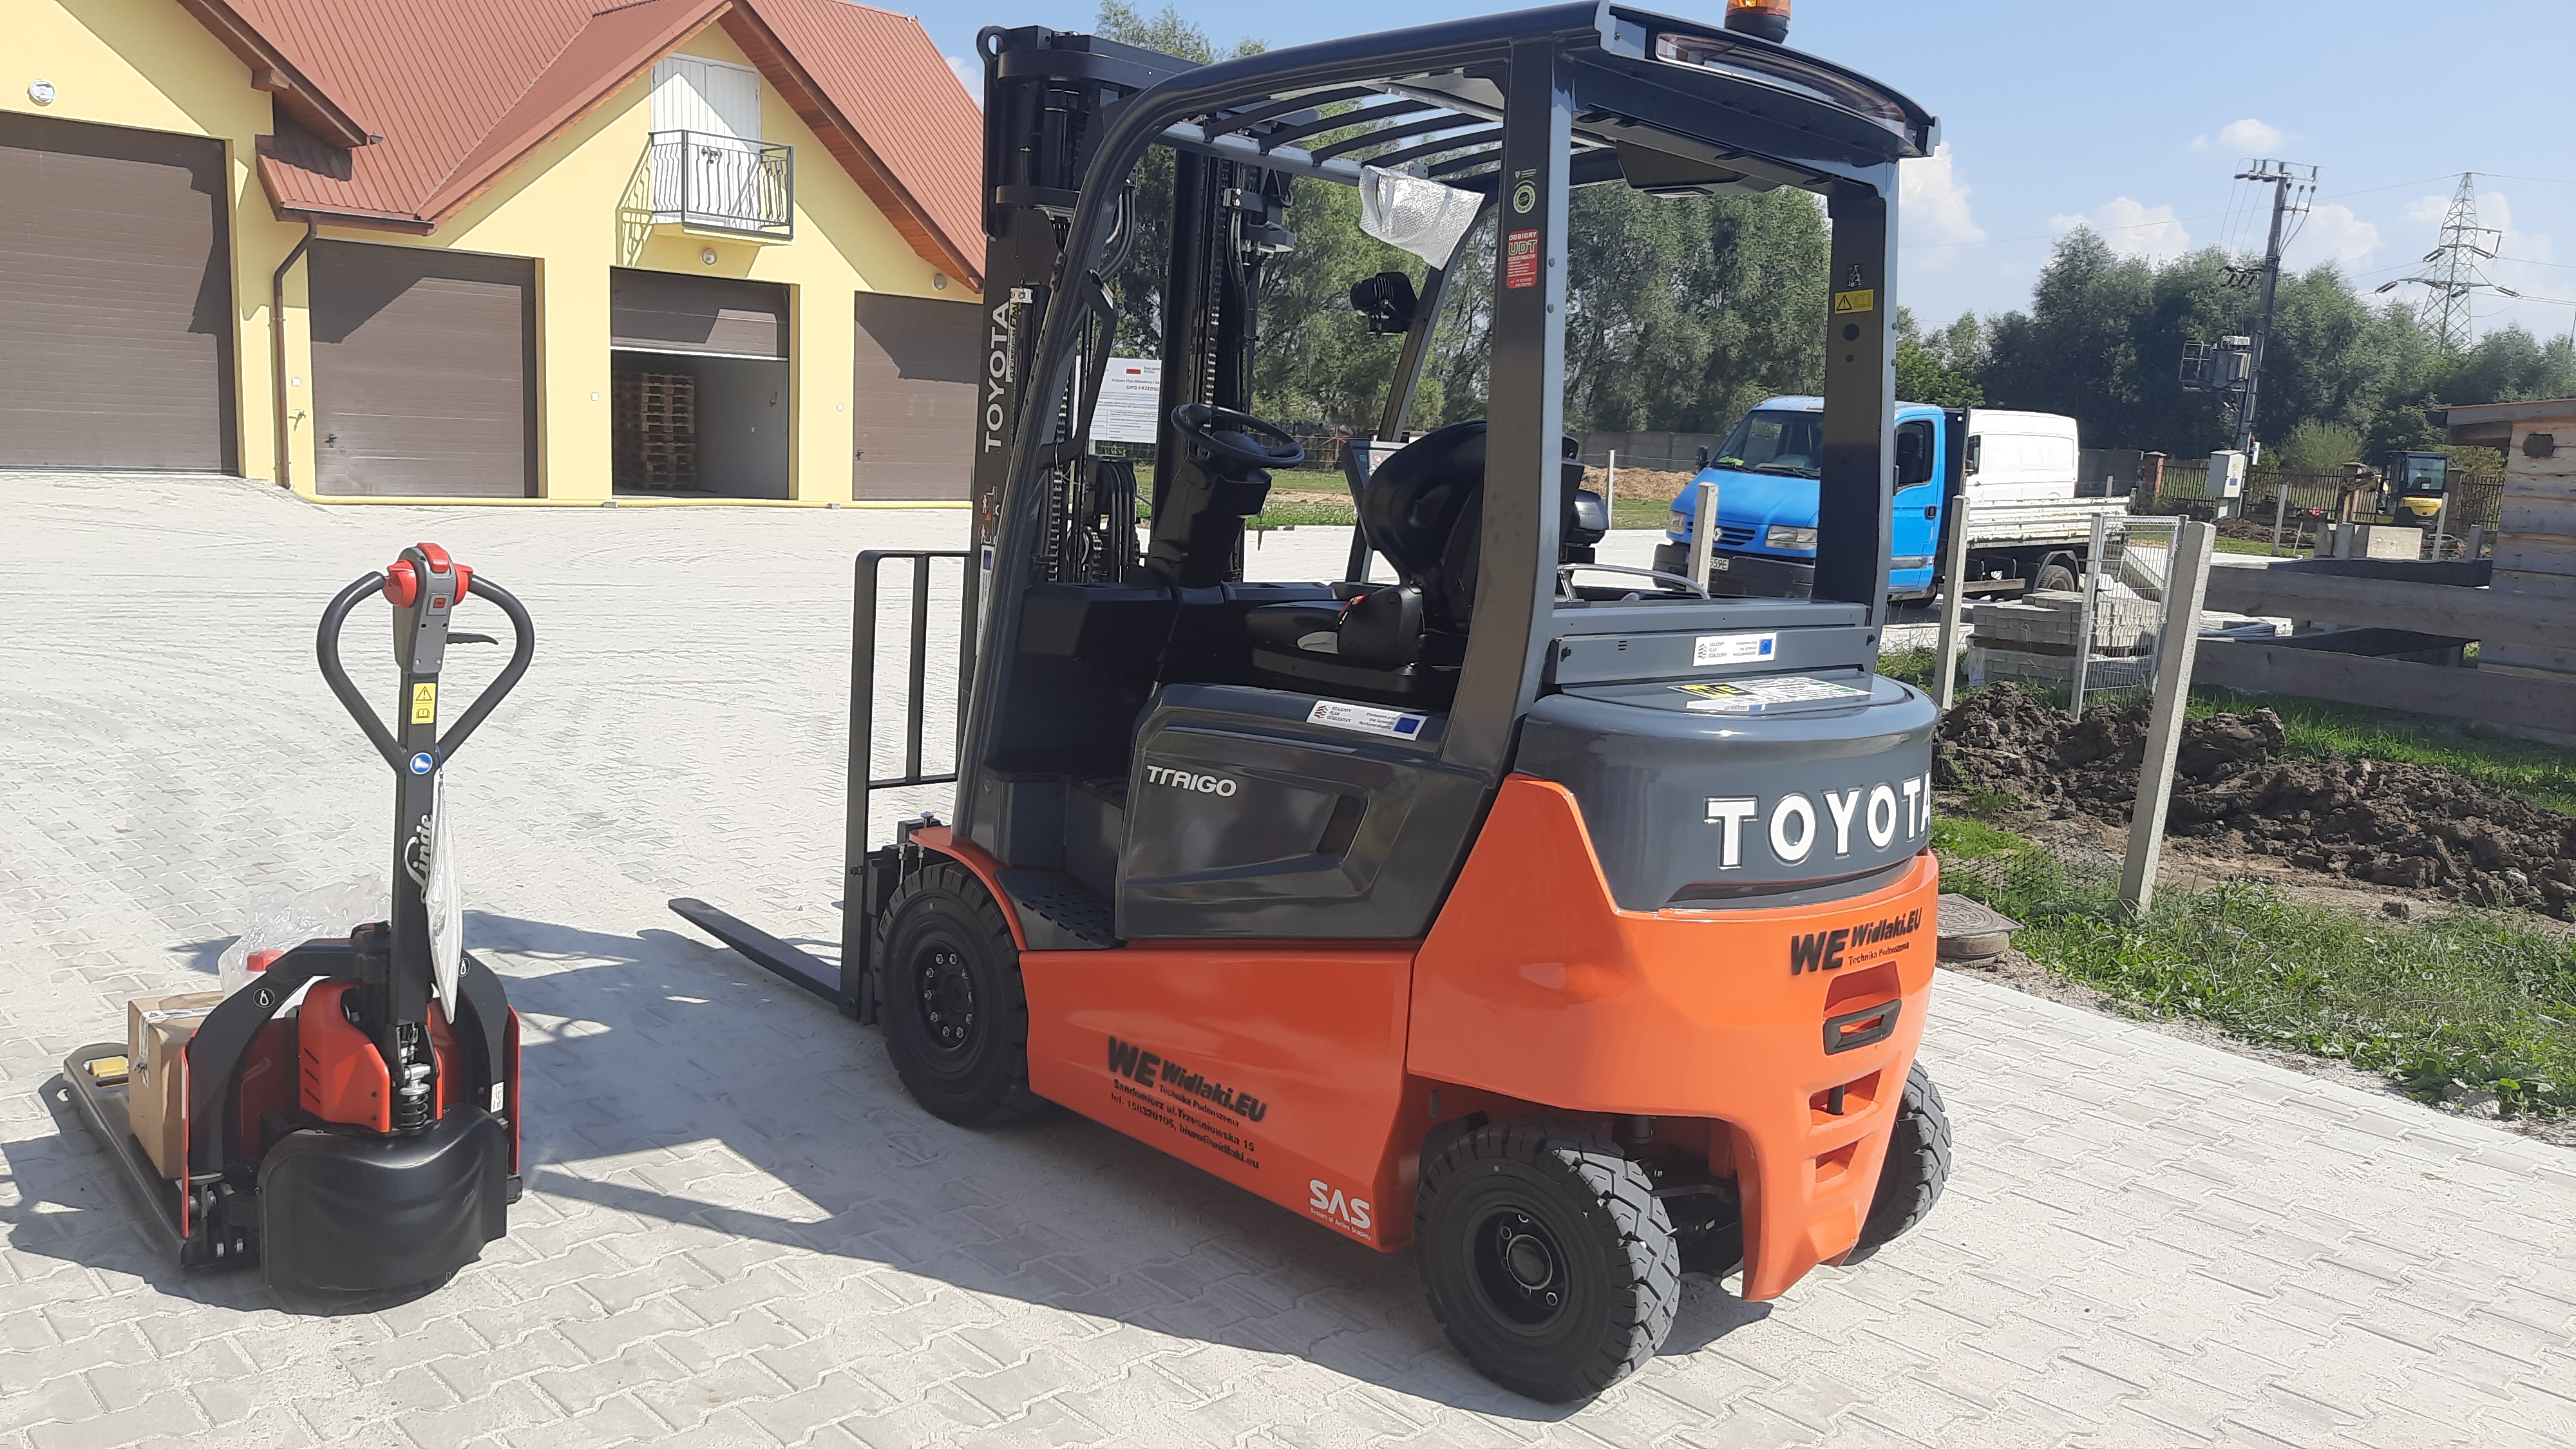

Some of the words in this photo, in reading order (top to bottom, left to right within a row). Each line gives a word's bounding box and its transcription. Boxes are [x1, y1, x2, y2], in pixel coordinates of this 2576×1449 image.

[1508, 232, 1537, 241] ODBIORY
[1508, 240, 1538, 256] UDT
[985, 300, 1010, 453] TOYOTA
[1147, 764, 1237, 797] TRAIGO
[1705, 771, 1931, 869] TOYOTA
[404, 814, 433, 904] Linde
[1791, 928, 1850, 975] WE
[1851, 907, 1922, 948] Widlaki.EU
[1848, 951, 1877, 966] Technika
[1108, 1036, 1160, 1088] WE
[1161, 1059, 1267, 1122] Widlaki.EU
[1159, 1084, 1192, 1106] Technika
[1193, 1099, 1240, 1128] Podnoszenia
[1111, 1092, 1124, 1106] tel.
[1179, 1123, 1260, 1169] biuro@widlaki.eu
[1113, 1079, 1164, 1110] Sandomierz
[1243, 1139, 1255, 1152] 15
[1309, 1179, 1370, 1229] SAS
